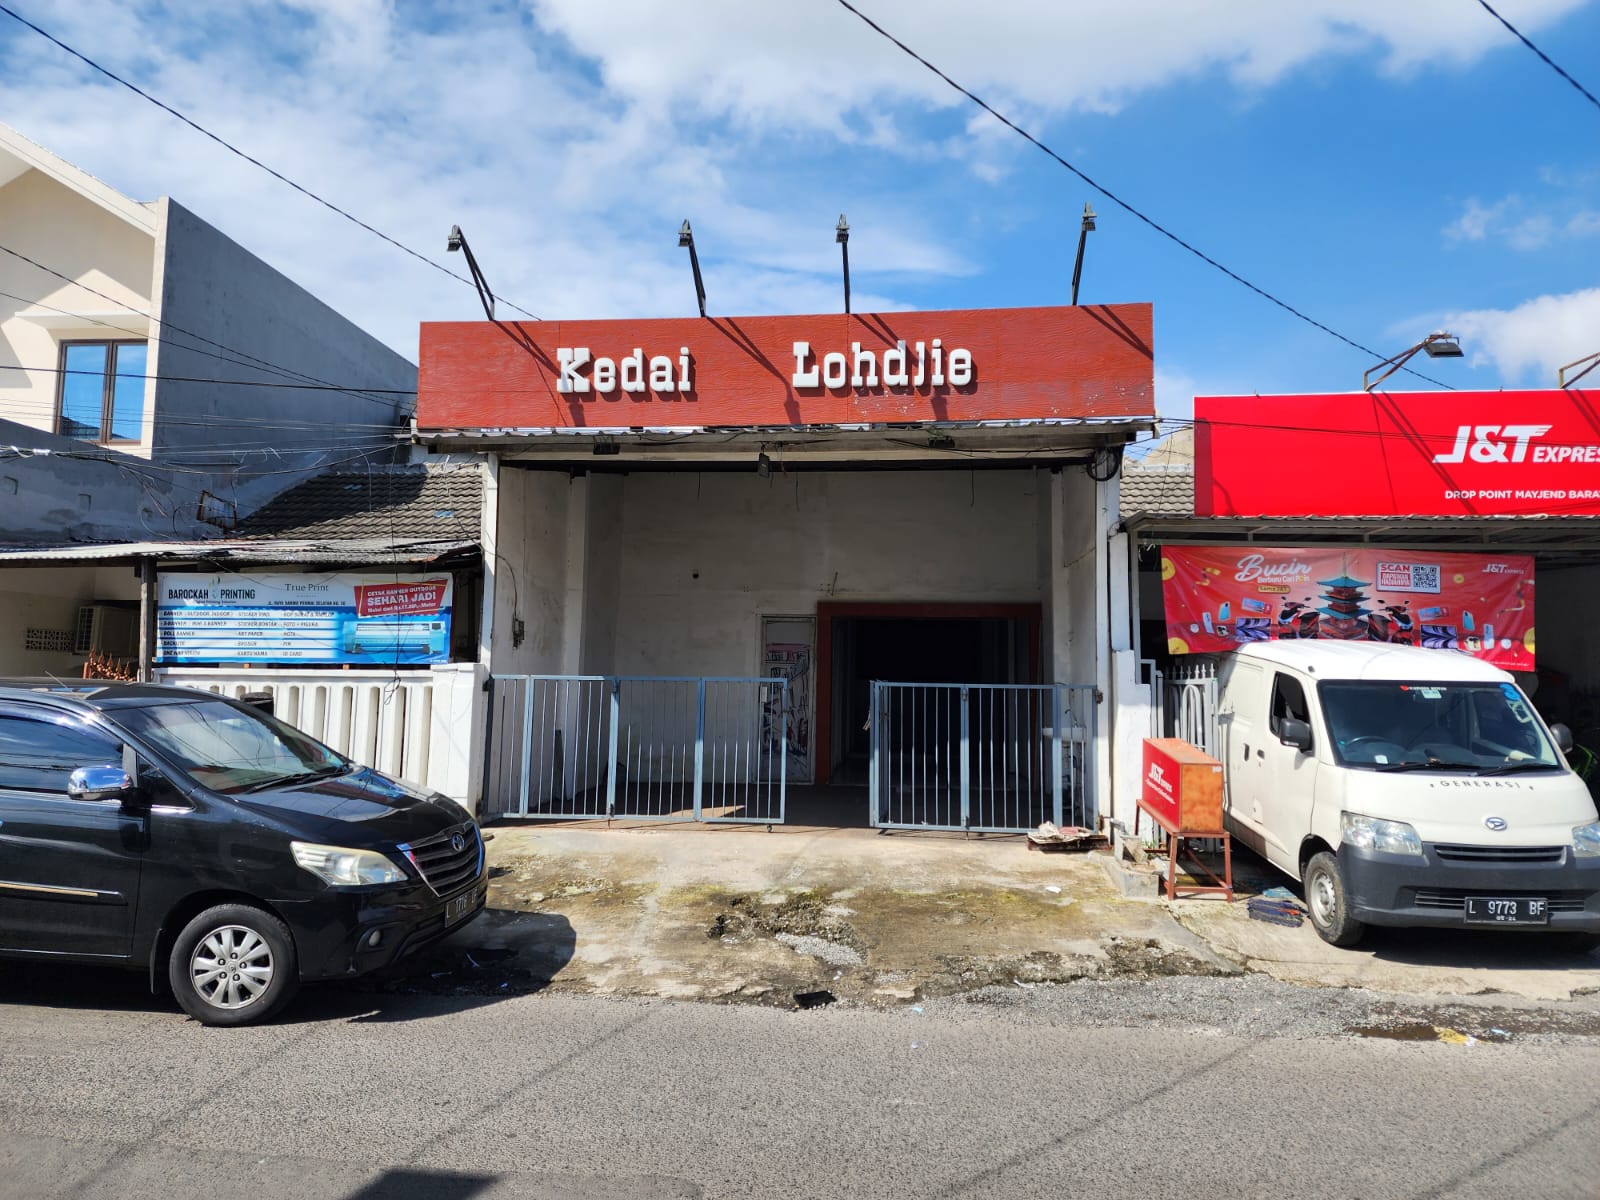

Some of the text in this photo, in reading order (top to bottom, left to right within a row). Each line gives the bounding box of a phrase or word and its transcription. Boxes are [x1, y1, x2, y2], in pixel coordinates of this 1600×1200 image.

[556, 346, 691, 393] Kedai
[1432, 425, 1553, 463] J&T
[1444, 490, 1600, 499] DROP POINT MAYJEND BARA
[1234, 554, 1312, 582] Bucin
[1482, 563, 1508, 573] J&T
[168, 588, 256, 600] BAROCKAH PRINTING
[367, 591, 436, 606] SEHARI JADI
[1468, 900, 1545, 915] L 9773 BF
